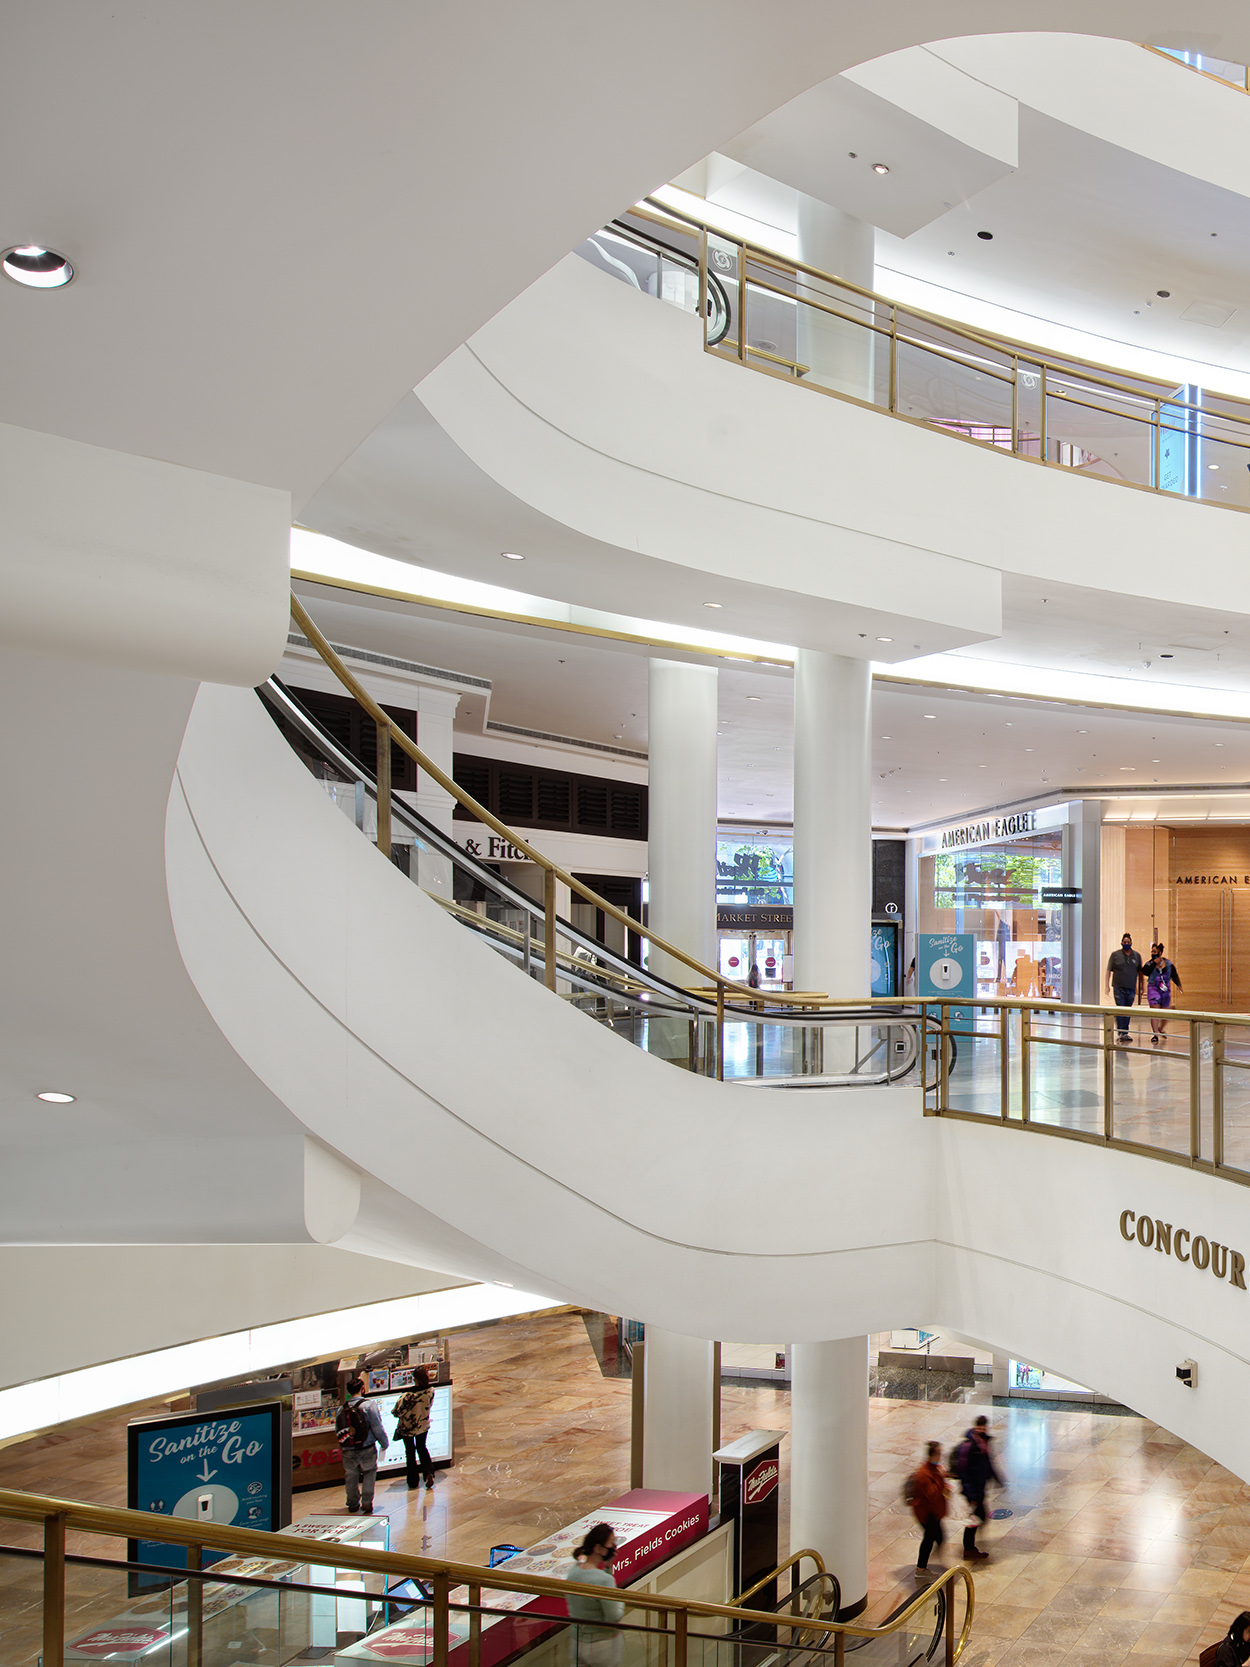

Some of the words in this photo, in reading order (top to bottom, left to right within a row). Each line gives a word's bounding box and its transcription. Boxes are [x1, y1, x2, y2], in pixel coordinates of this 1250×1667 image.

[941, 822, 990, 849] AMERICAN
[995, 812, 1030, 838] EAGLE
[465, 838, 482, 856] &
[1176, 876, 1238, 885] AMERICAN
[760, 912, 794, 923] STREE
[928, 936, 958, 948] Sanitize
[951, 942, 964, 954] Go
[149, 1421, 242, 1462] Sanitize
[180, 1454, 196, 1464] on
[199, 1445, 218, 1458] the
[221, 1435, 264, 1464] Go
[612, 1560, 632, 1575] Mrs.
[634, 1538, 663, 1560] Fields
[665, 1513, 700, 1541] Cookies
